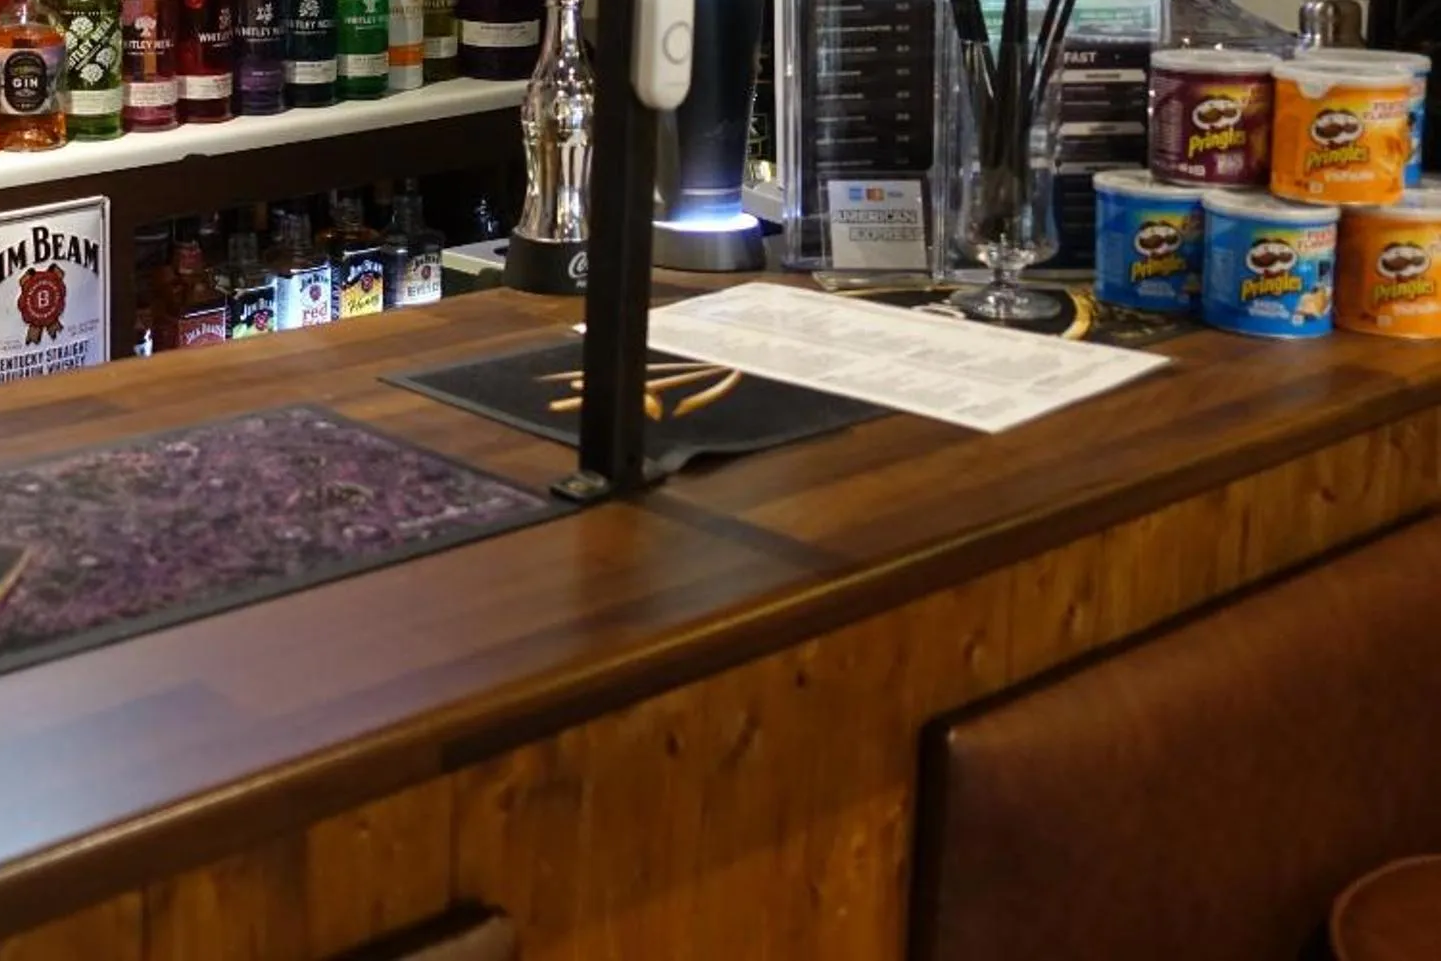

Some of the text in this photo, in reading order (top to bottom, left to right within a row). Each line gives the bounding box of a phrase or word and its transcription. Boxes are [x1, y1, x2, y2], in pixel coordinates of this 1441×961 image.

[12, 76, 39, 89] GIN
[1188, 127, 1246, 158] Pringles
[1307, 143, 1371, 171] Pringles
[833, 209, 919, 224] AMERICAN
[849, 225, 921, 241] EXPRESS
[32, 226, 100, 278] BEAM
[1130, 255, 1187, 283] Pringles
[38, 290, 50, 308] B
[1240, 271, 1303, 302] Pringles
[1373, 278, 1437, 304] Pringles
[301, 305, 329, 320] red
[348, 293, 381, 313] Honey
[45, 339, 90, 364] STRAIGHT
